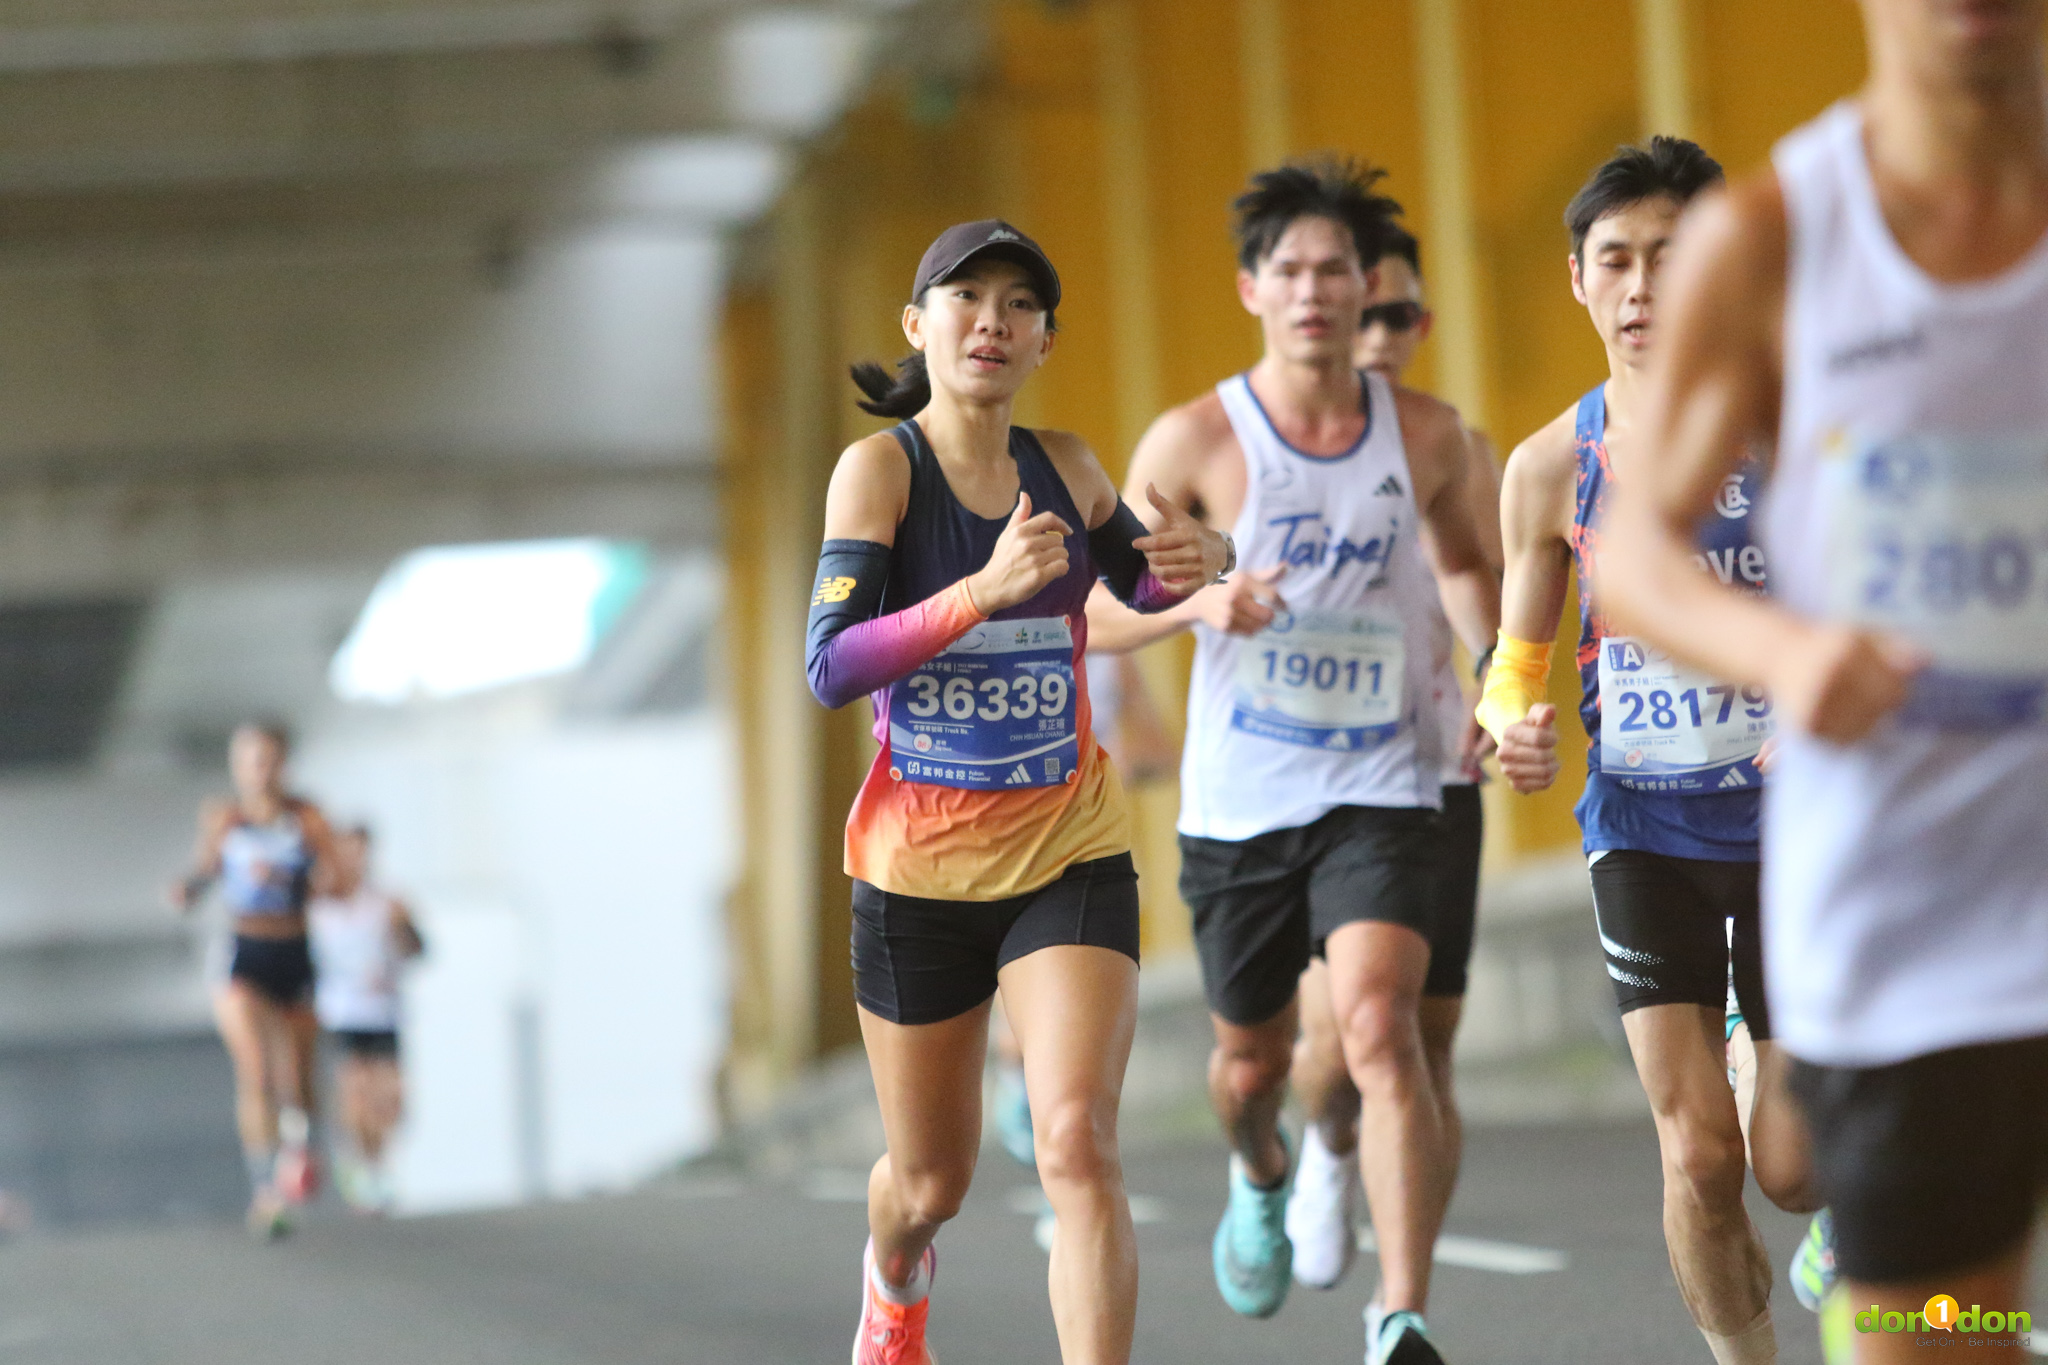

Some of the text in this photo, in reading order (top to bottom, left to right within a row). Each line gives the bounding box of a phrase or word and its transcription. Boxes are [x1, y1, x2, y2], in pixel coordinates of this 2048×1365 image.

[1864, 525, 2048, 616] 280
[1262, 650, 1384, 695] 19011
[1622, 643, 1643, 668] A
[907, 673, 1068, 721] 36339
[1618, 684, 1775, 733] 28179
[922, 765, 966, 781] 富邦金控
